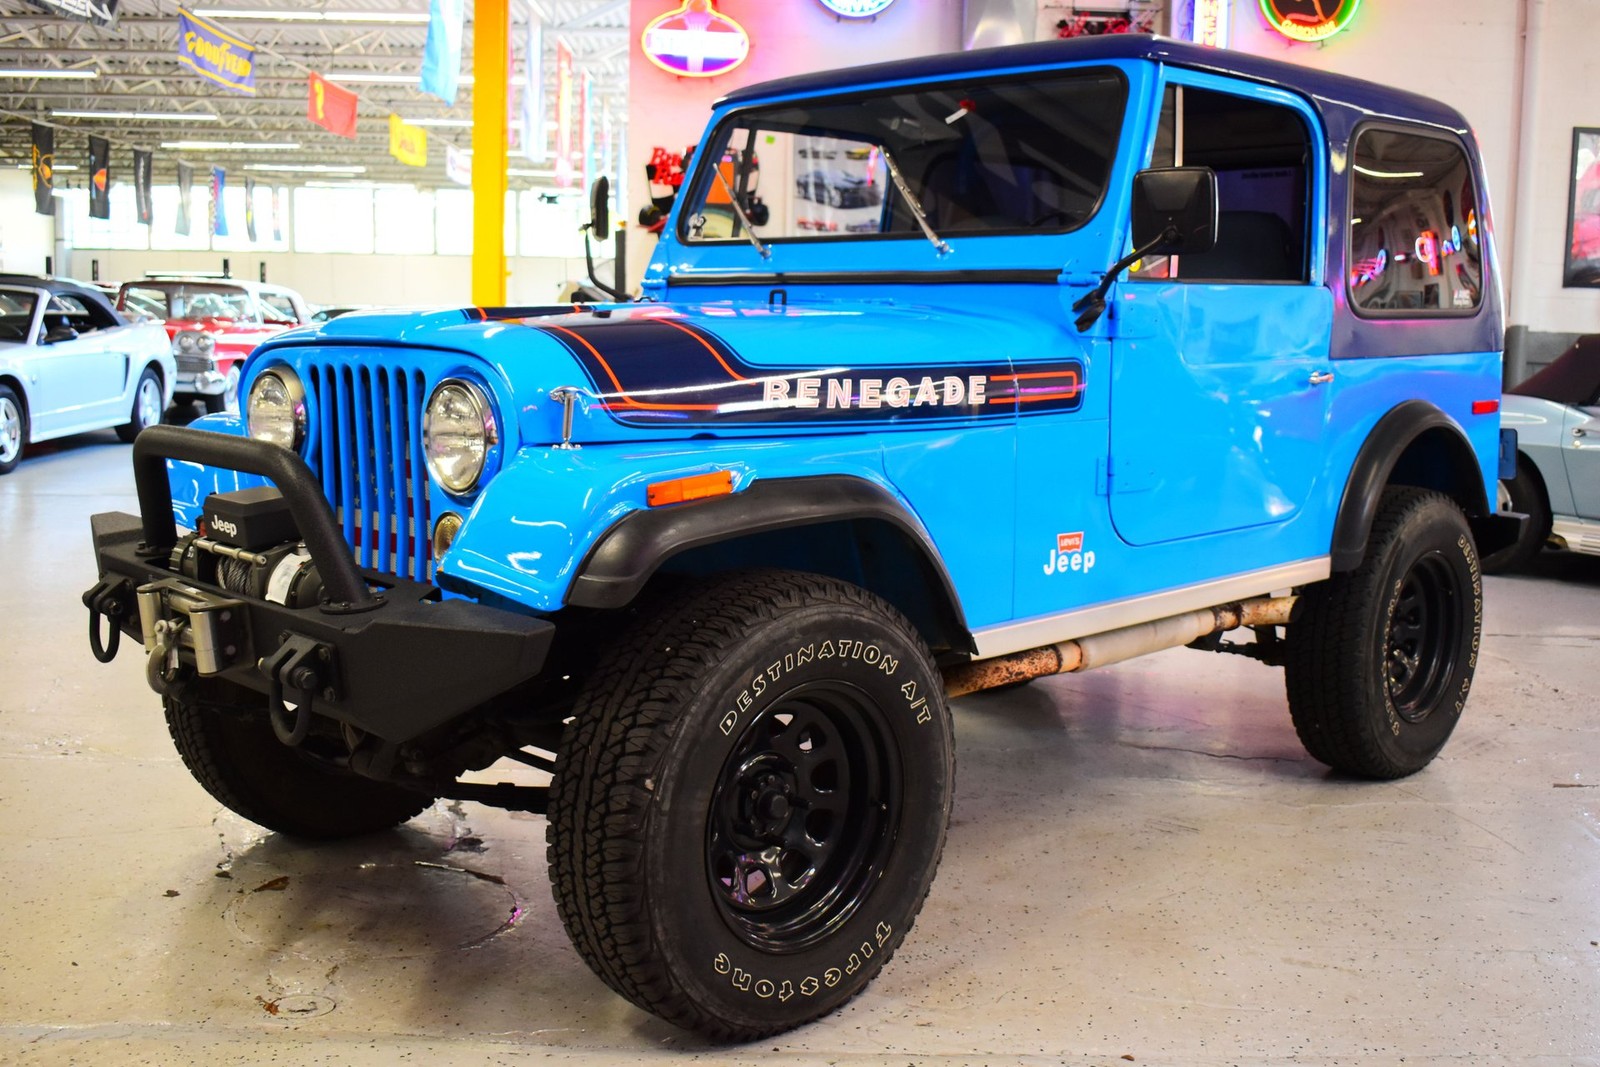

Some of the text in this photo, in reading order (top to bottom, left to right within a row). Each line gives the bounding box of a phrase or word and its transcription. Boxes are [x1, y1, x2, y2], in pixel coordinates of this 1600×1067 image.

[184, 31, 252, 77] GOODYEAR
[763, 375, 987, 409] RENEGADE
[211, 514, 238, 538] Jeep
[1043, 549, 1096, 575] Jeep
[1457, 534, 1481, 668] DESTINATION
[719, 640, 932, 736] DESTINATION A/T
[714, 921, 892, 1003] Firestone
